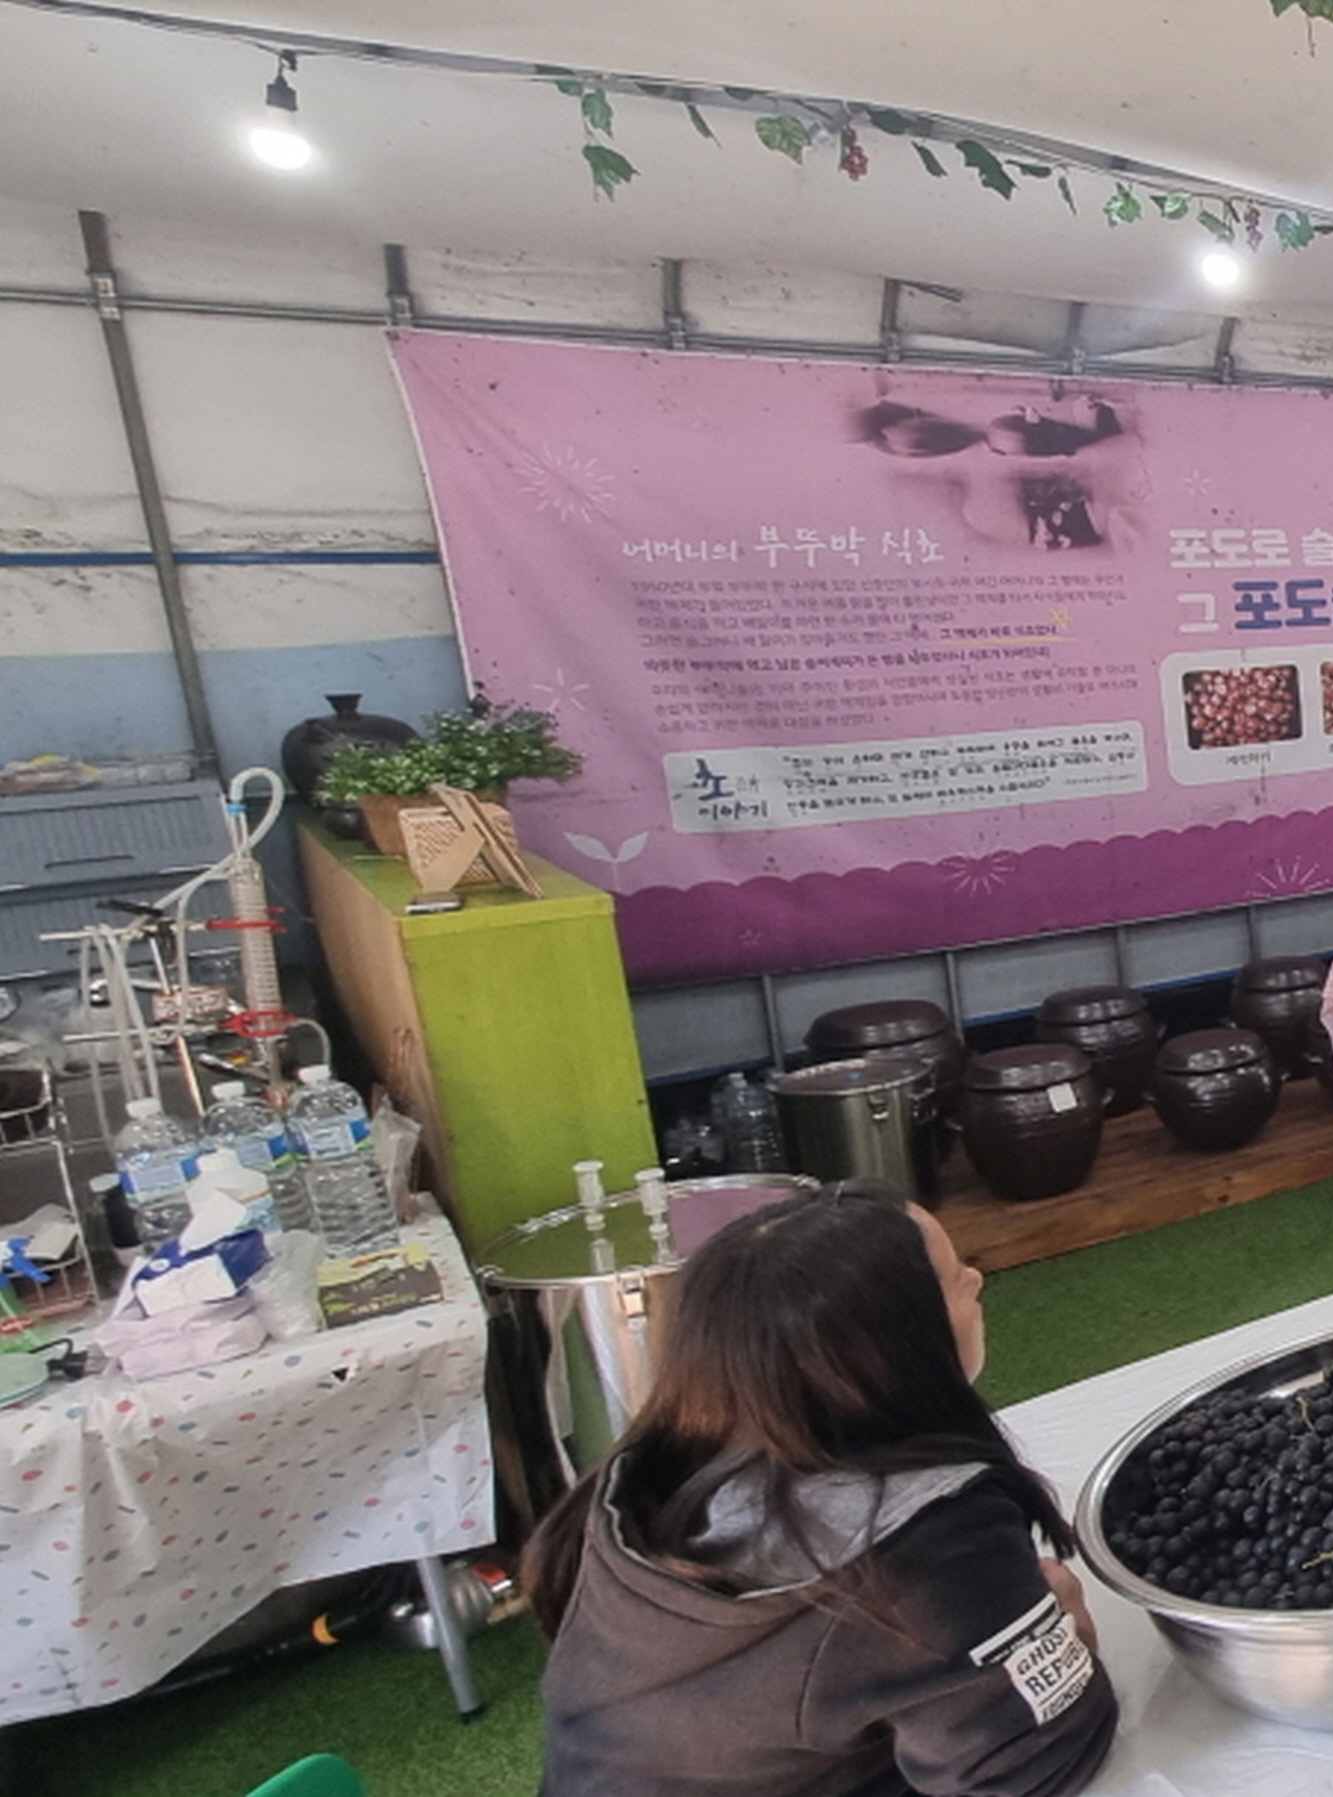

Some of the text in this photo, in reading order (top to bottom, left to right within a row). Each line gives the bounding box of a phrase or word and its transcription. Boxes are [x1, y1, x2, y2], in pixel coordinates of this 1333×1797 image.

[622, 526, 945, 568] 어머니의 부뚜막 식초
[1169, 528, 1292, 568] 포도로
[1177, 593, 1219, 633] 그
[694, 757, 735, 802] 초
[698, 801, 768, 821] 이야기
